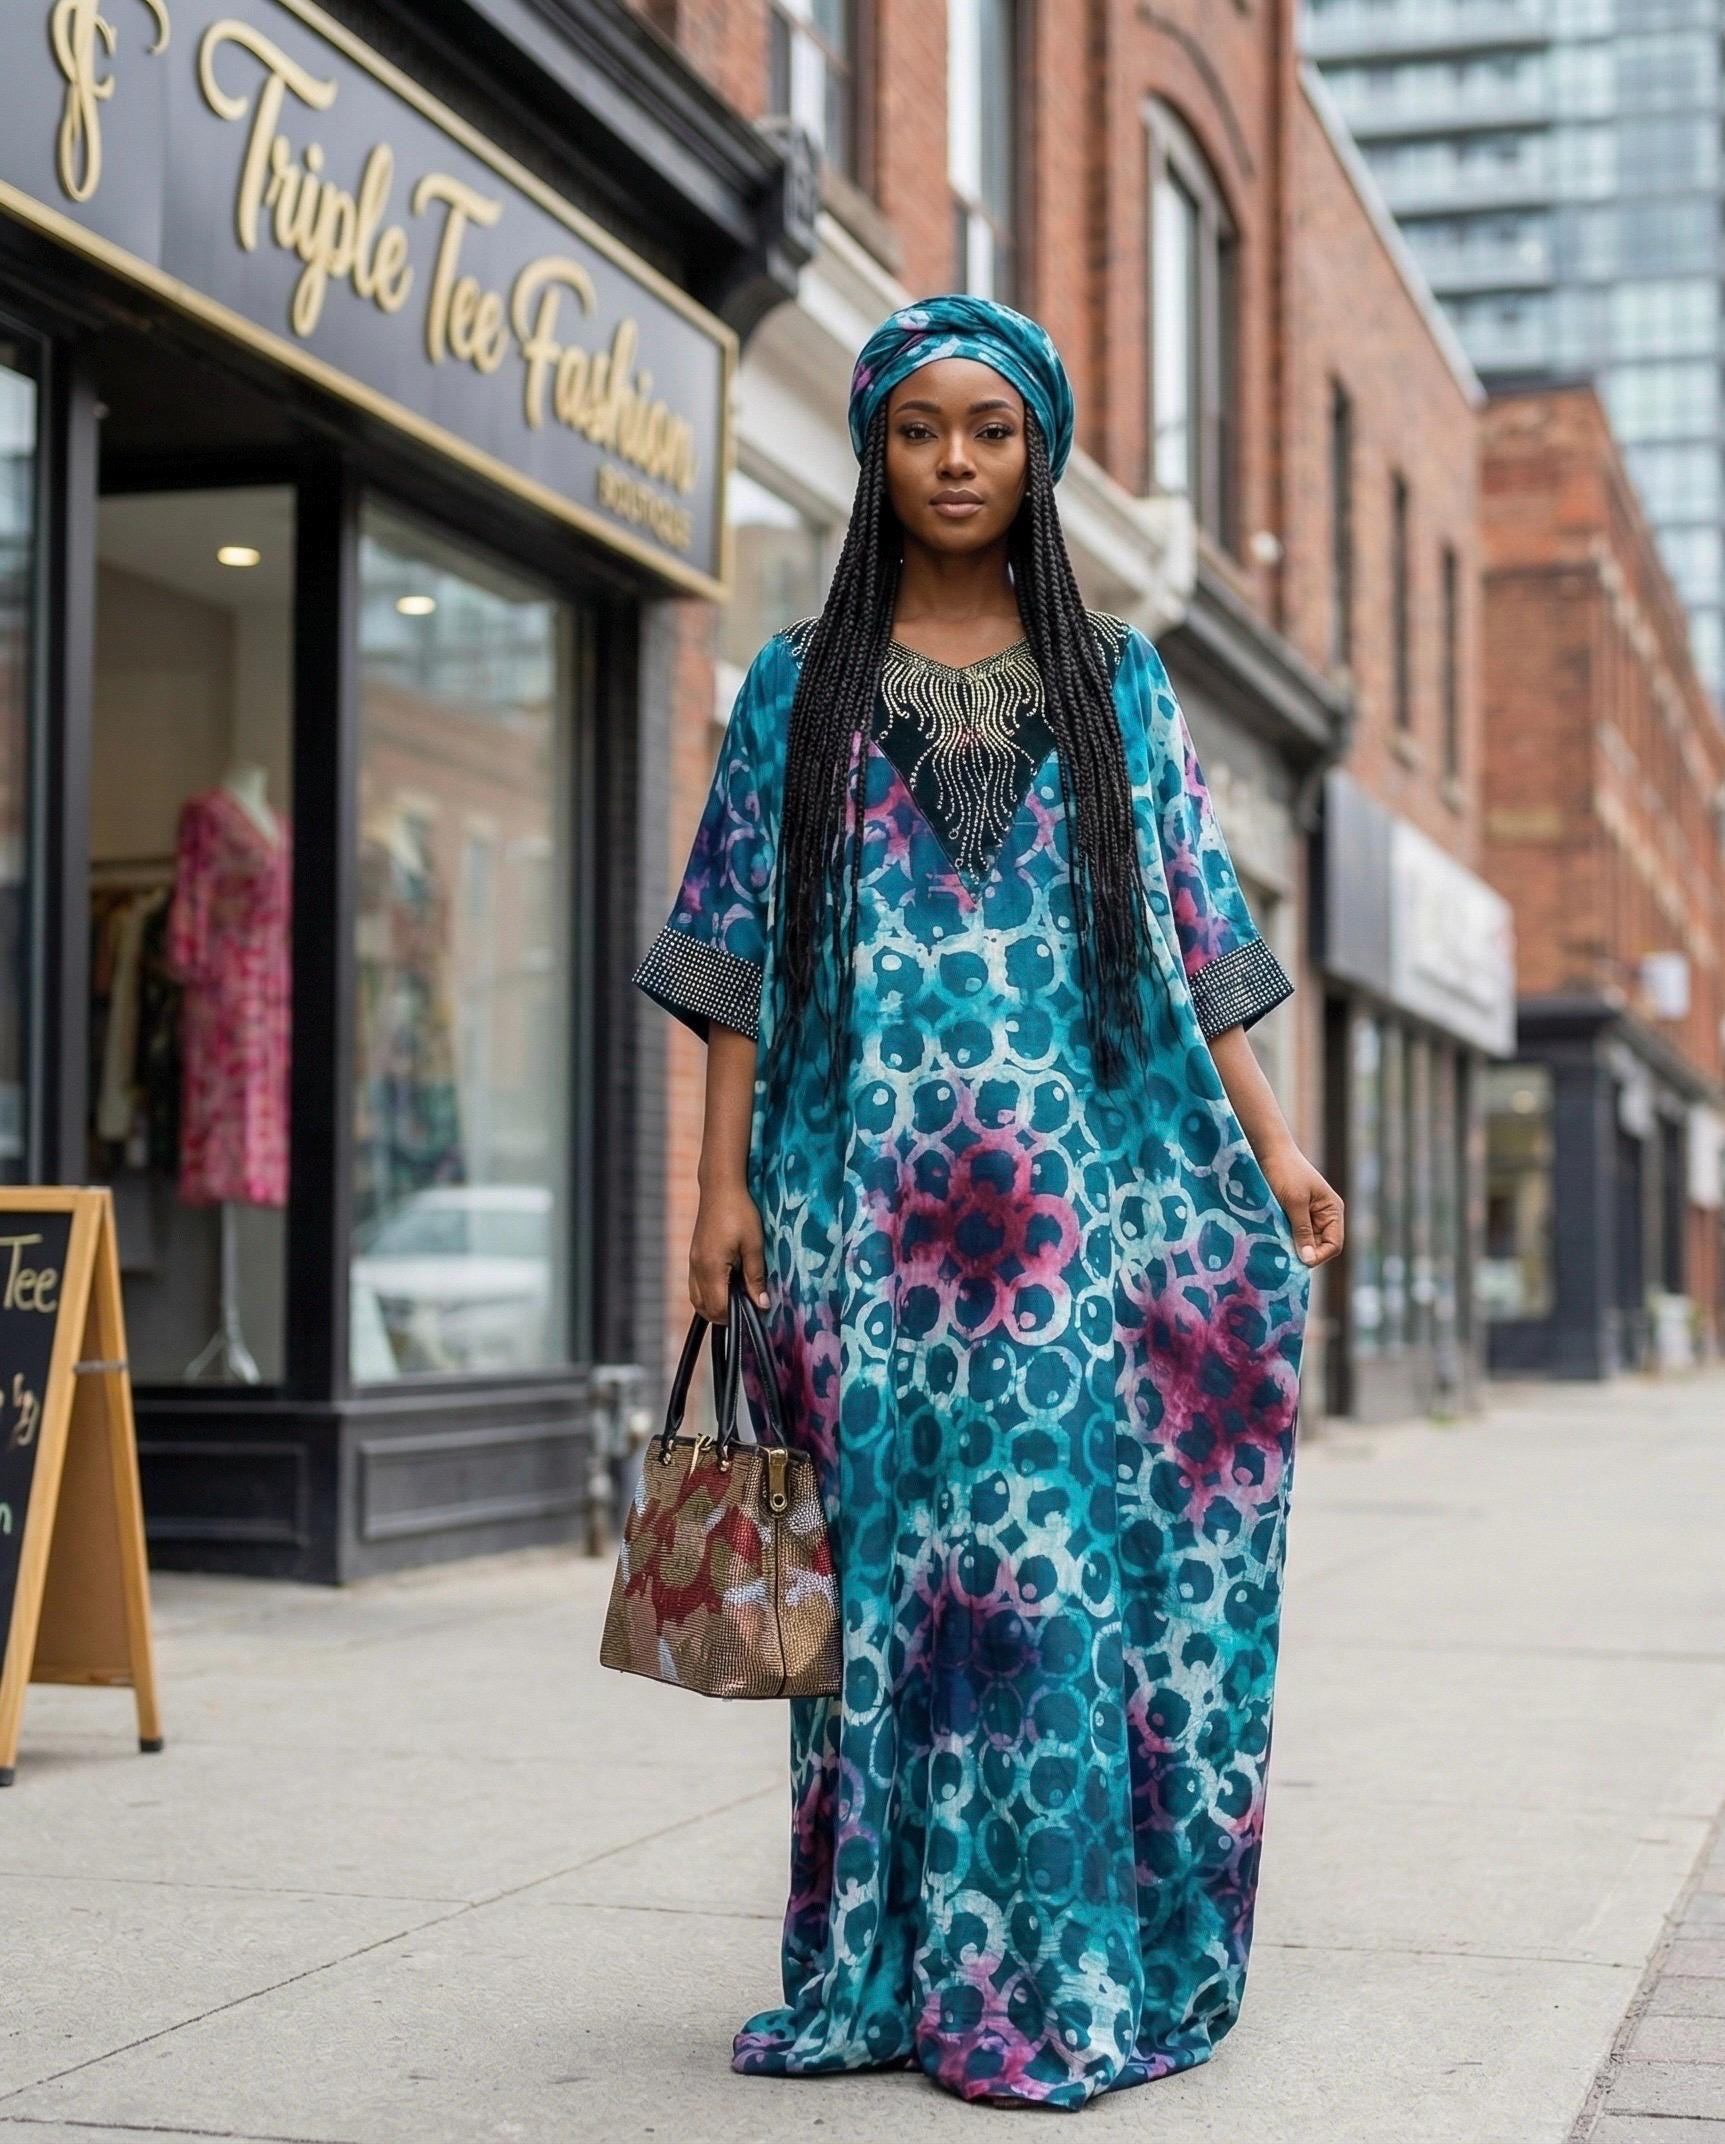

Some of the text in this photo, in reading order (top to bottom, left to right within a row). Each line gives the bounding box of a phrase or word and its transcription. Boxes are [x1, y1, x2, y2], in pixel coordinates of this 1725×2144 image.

[200, 18, 413, 338] Triple
[413, 172, 509, 374] Tee
[511, 256, 695, 494] Fashion
[0, 1233, 58, 1313] Tee
